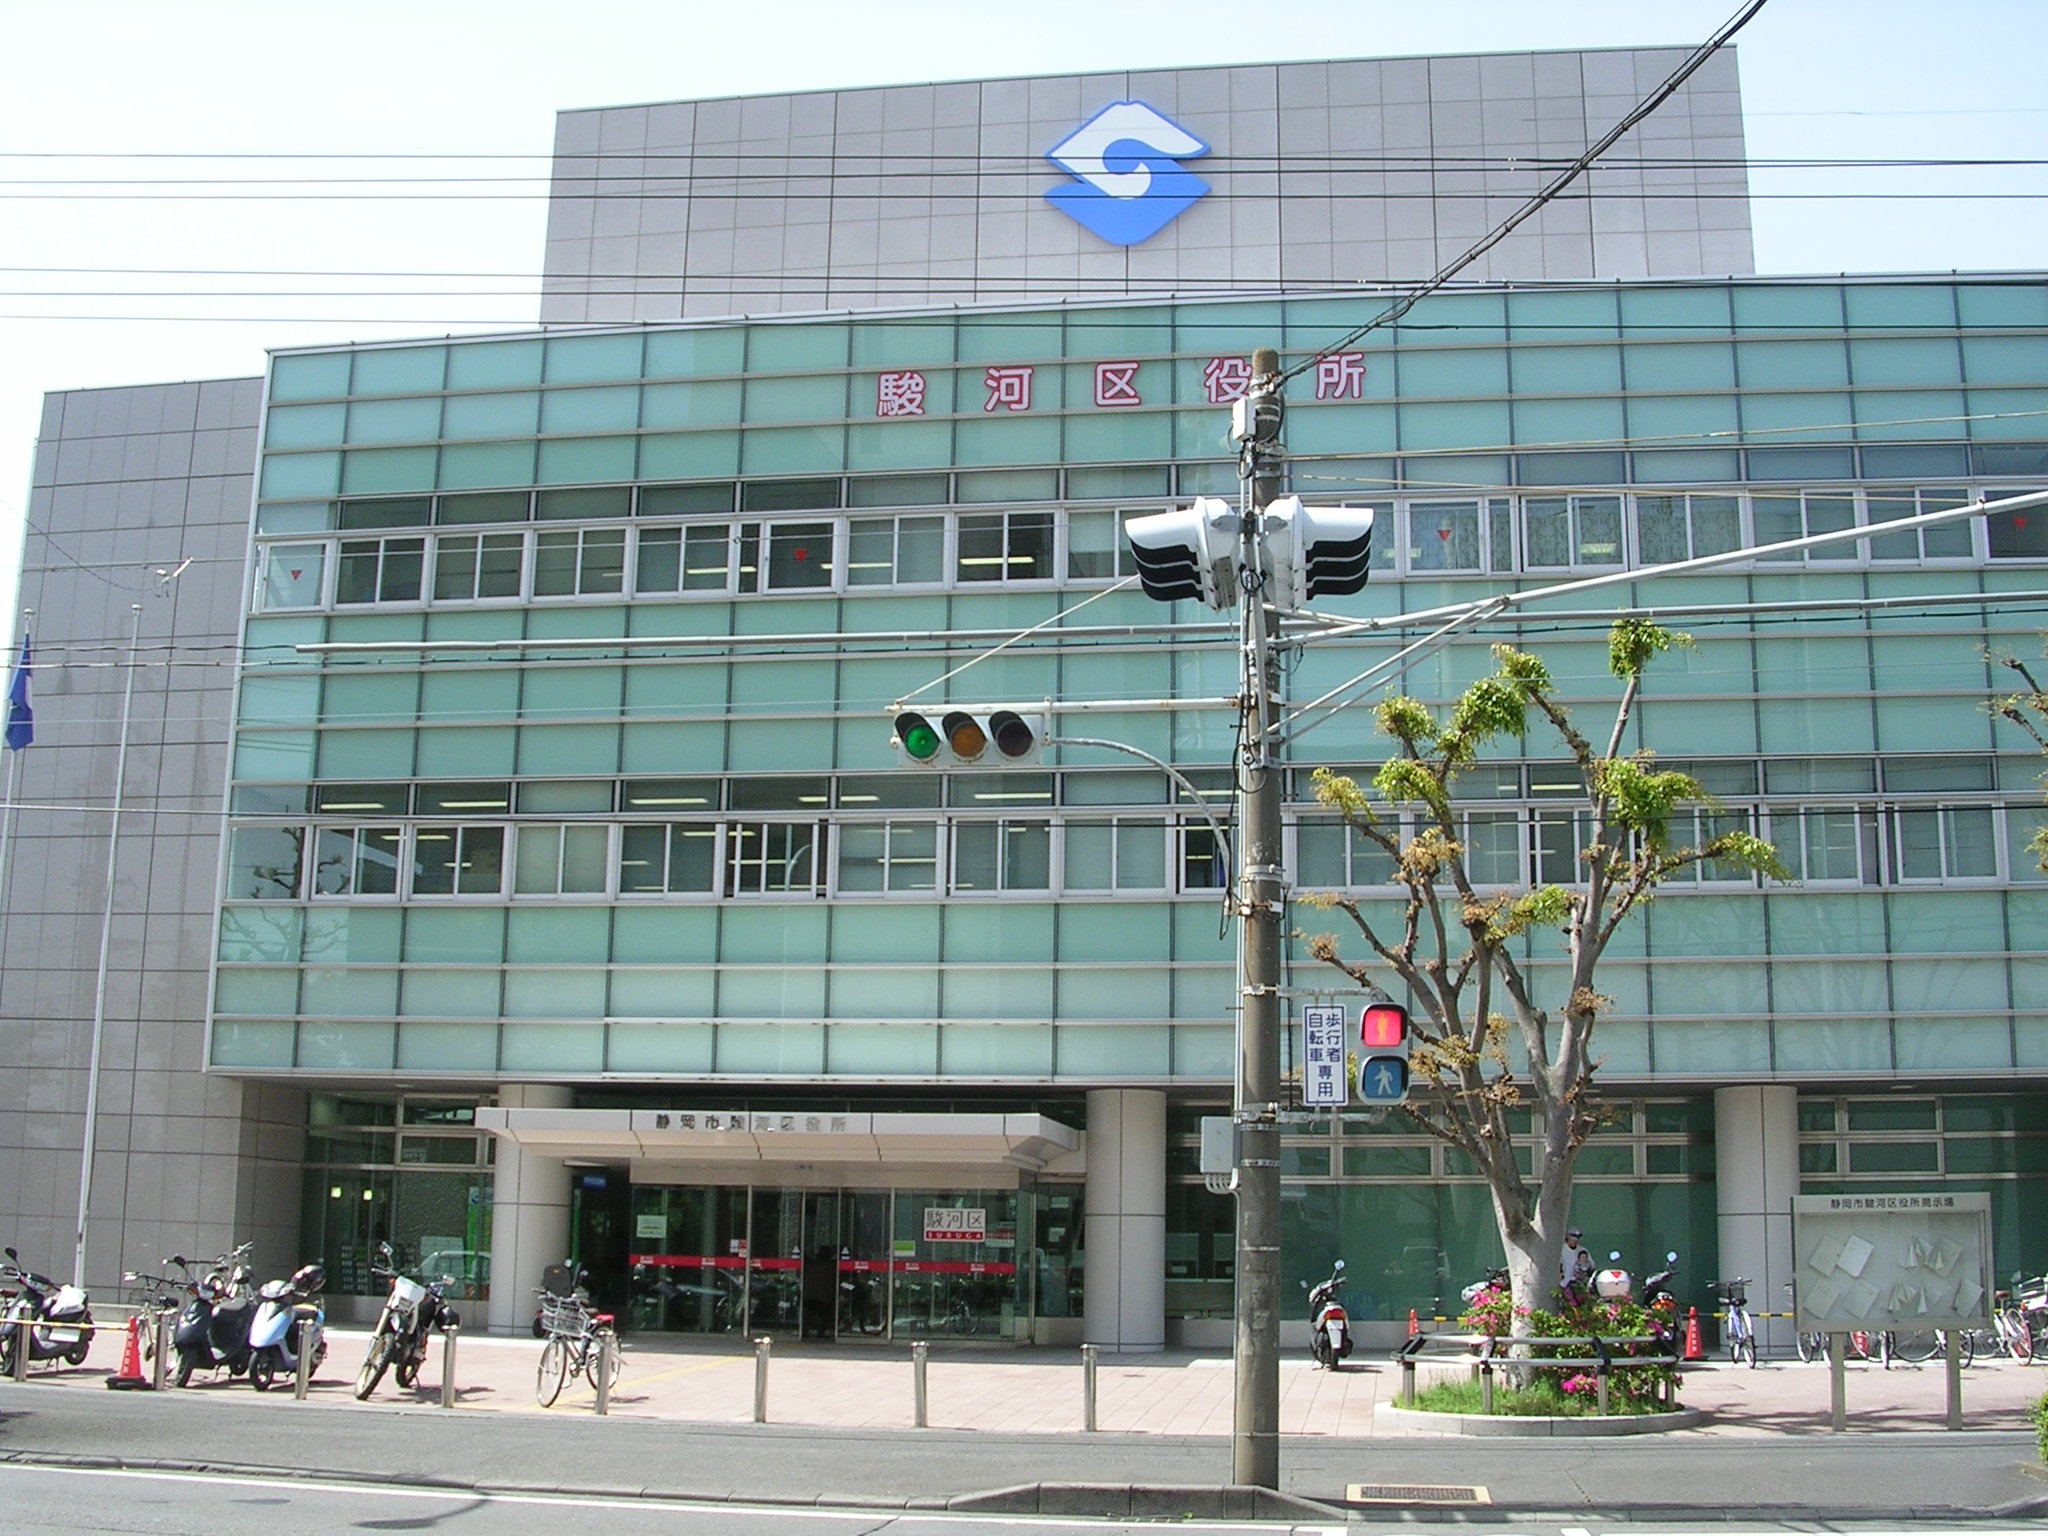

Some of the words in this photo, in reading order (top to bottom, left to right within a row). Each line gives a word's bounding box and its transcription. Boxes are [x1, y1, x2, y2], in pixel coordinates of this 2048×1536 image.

[876, 353, 1366, 417] 駿河区役所
[1308, 1013, 1324, 1062] 自転車
[1325, 1013, 1340, 1062] 歩行者
[1317, 1065, 1333, 1097] 専用
[656, 1113, 846, 1132] 静岡市駿河区役所
[926, 1210, 984, 1228] 駿河区
